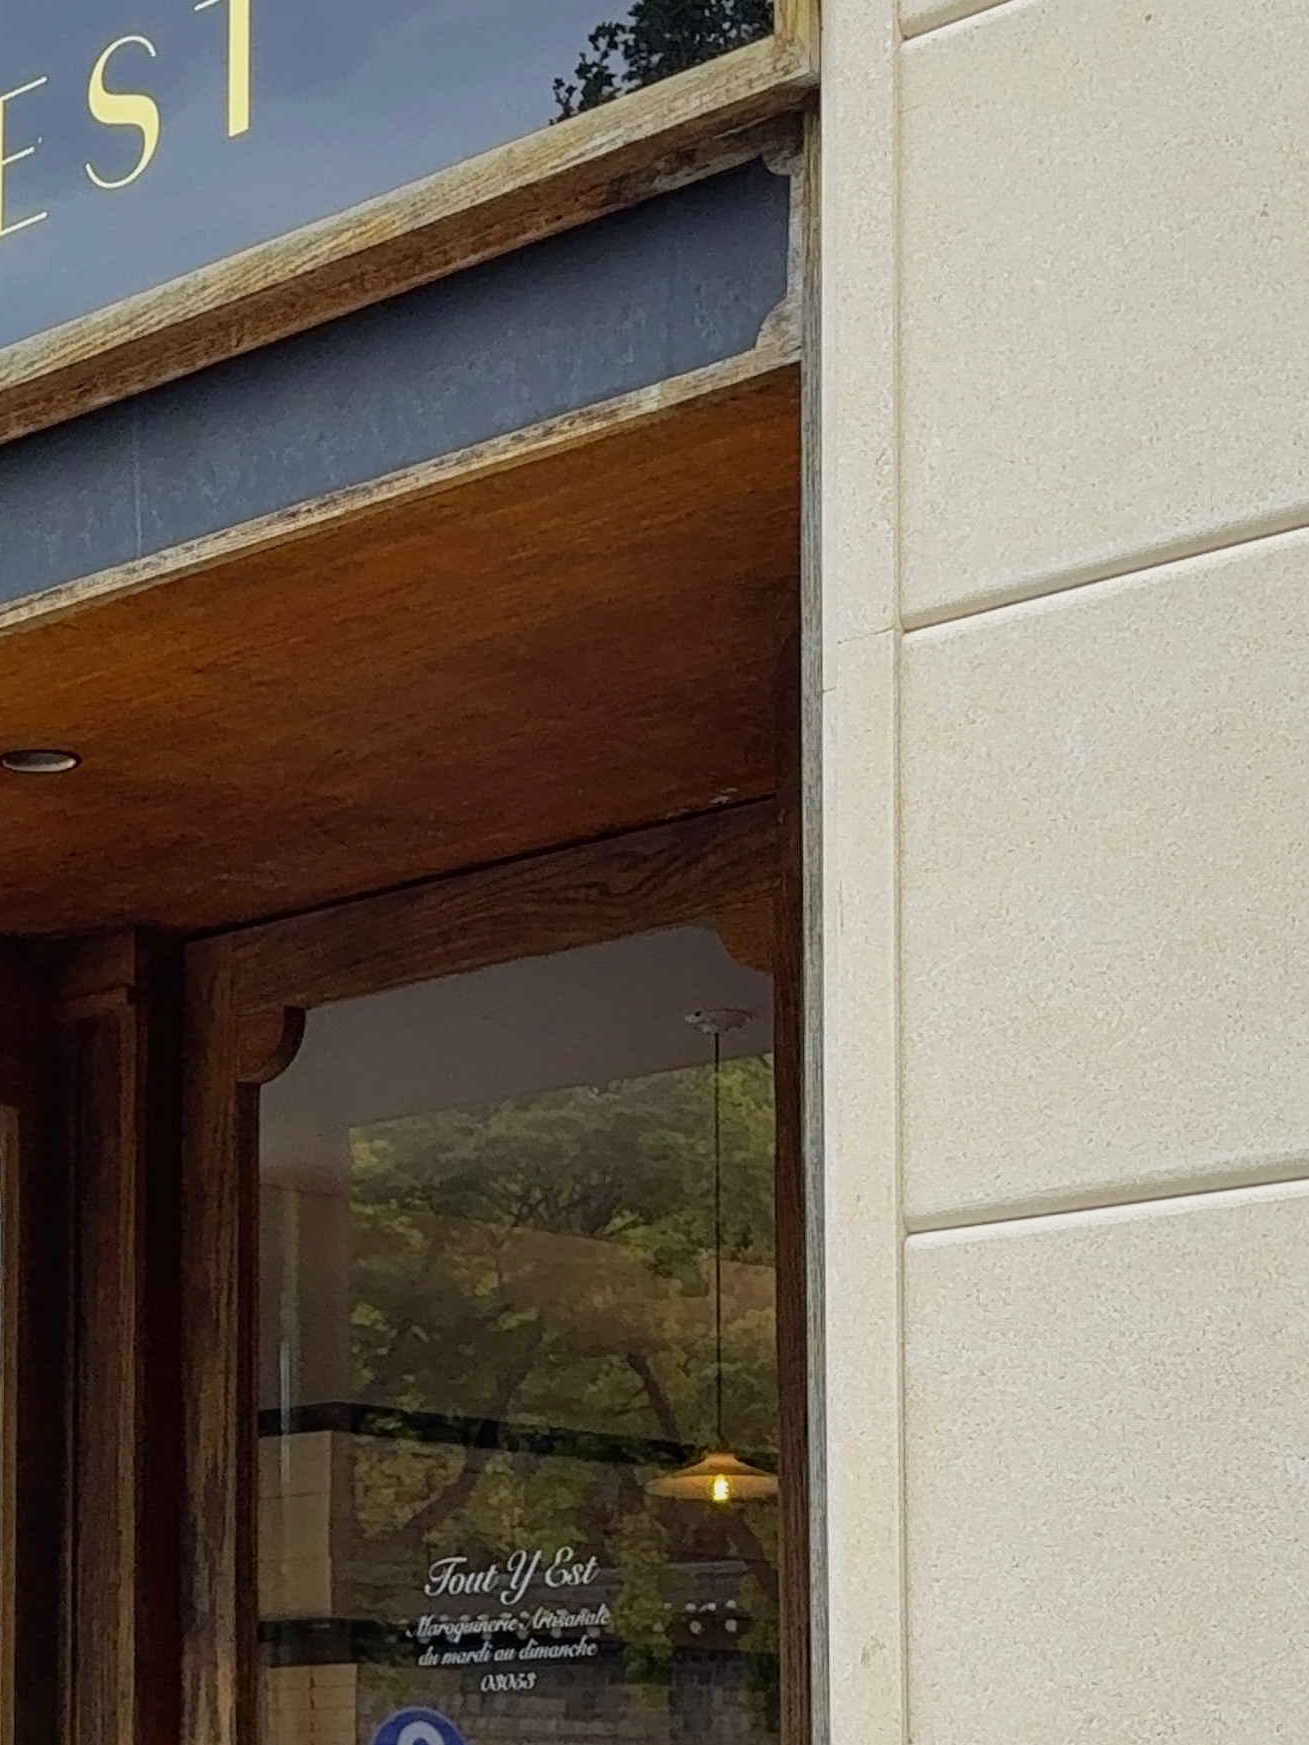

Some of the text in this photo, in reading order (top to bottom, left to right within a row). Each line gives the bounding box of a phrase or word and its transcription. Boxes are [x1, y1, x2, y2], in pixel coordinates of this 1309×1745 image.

[424, 1546, 600, 1605] Tout Y Est
[418, 1634, 599, 1666] du mardi au dimanche
